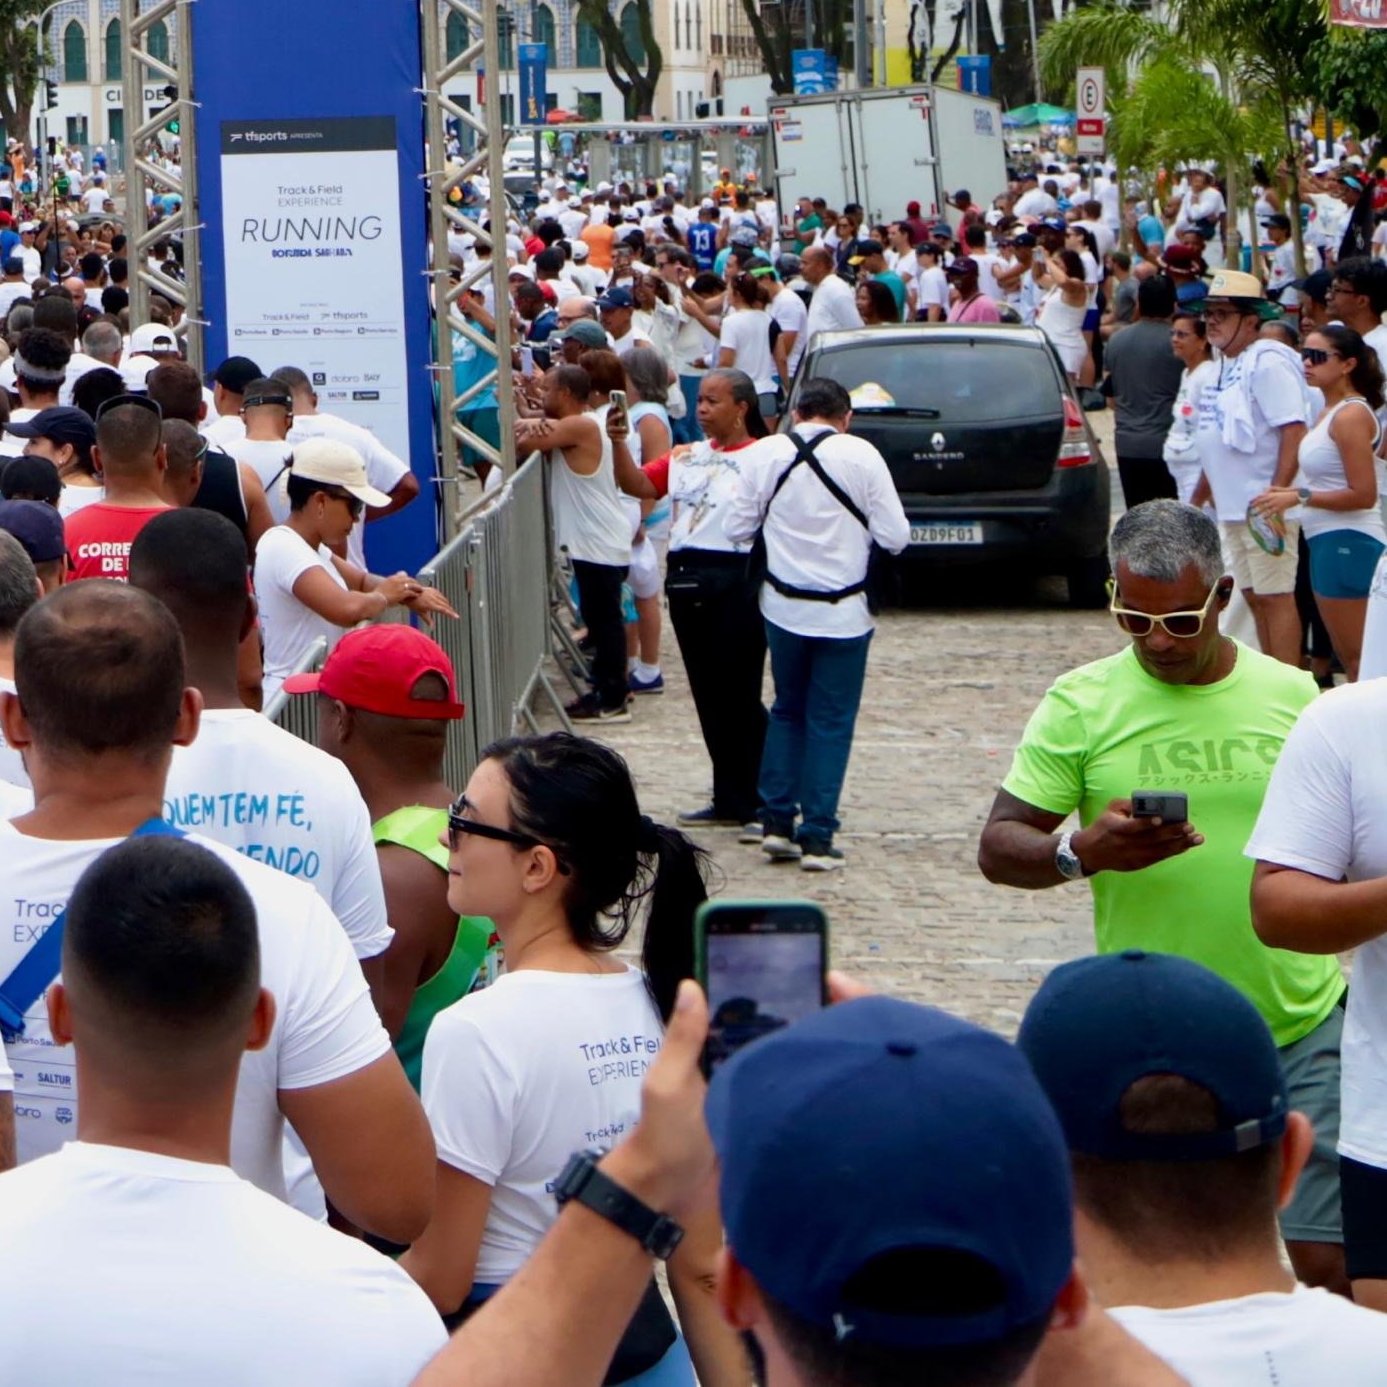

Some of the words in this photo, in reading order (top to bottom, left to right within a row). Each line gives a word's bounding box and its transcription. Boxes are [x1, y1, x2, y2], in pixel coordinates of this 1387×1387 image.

[1086, 85, 1093, 105] E
[245, 131, 287, 143] tfsports
[277, 186, 306, 195] Track
[317, 185, 343, 194] Field
[278, 197, 343, 207] EXPERIENCE
[241, 216, 382, 242] RUNNING
[78, 542, 133, 558] CORRE
[102, 557, 123, 571] DE
[1138, 739, 1282, 775] ASICS
[1139, 772, 1270, 787] アシックス・ランニ
[163, 792, 215, 828] QUEM
[219, 792, 268, 827] TEM
[14, 899, 66, 918] Trac
[634, 1033, 662, 1054] Fiel
